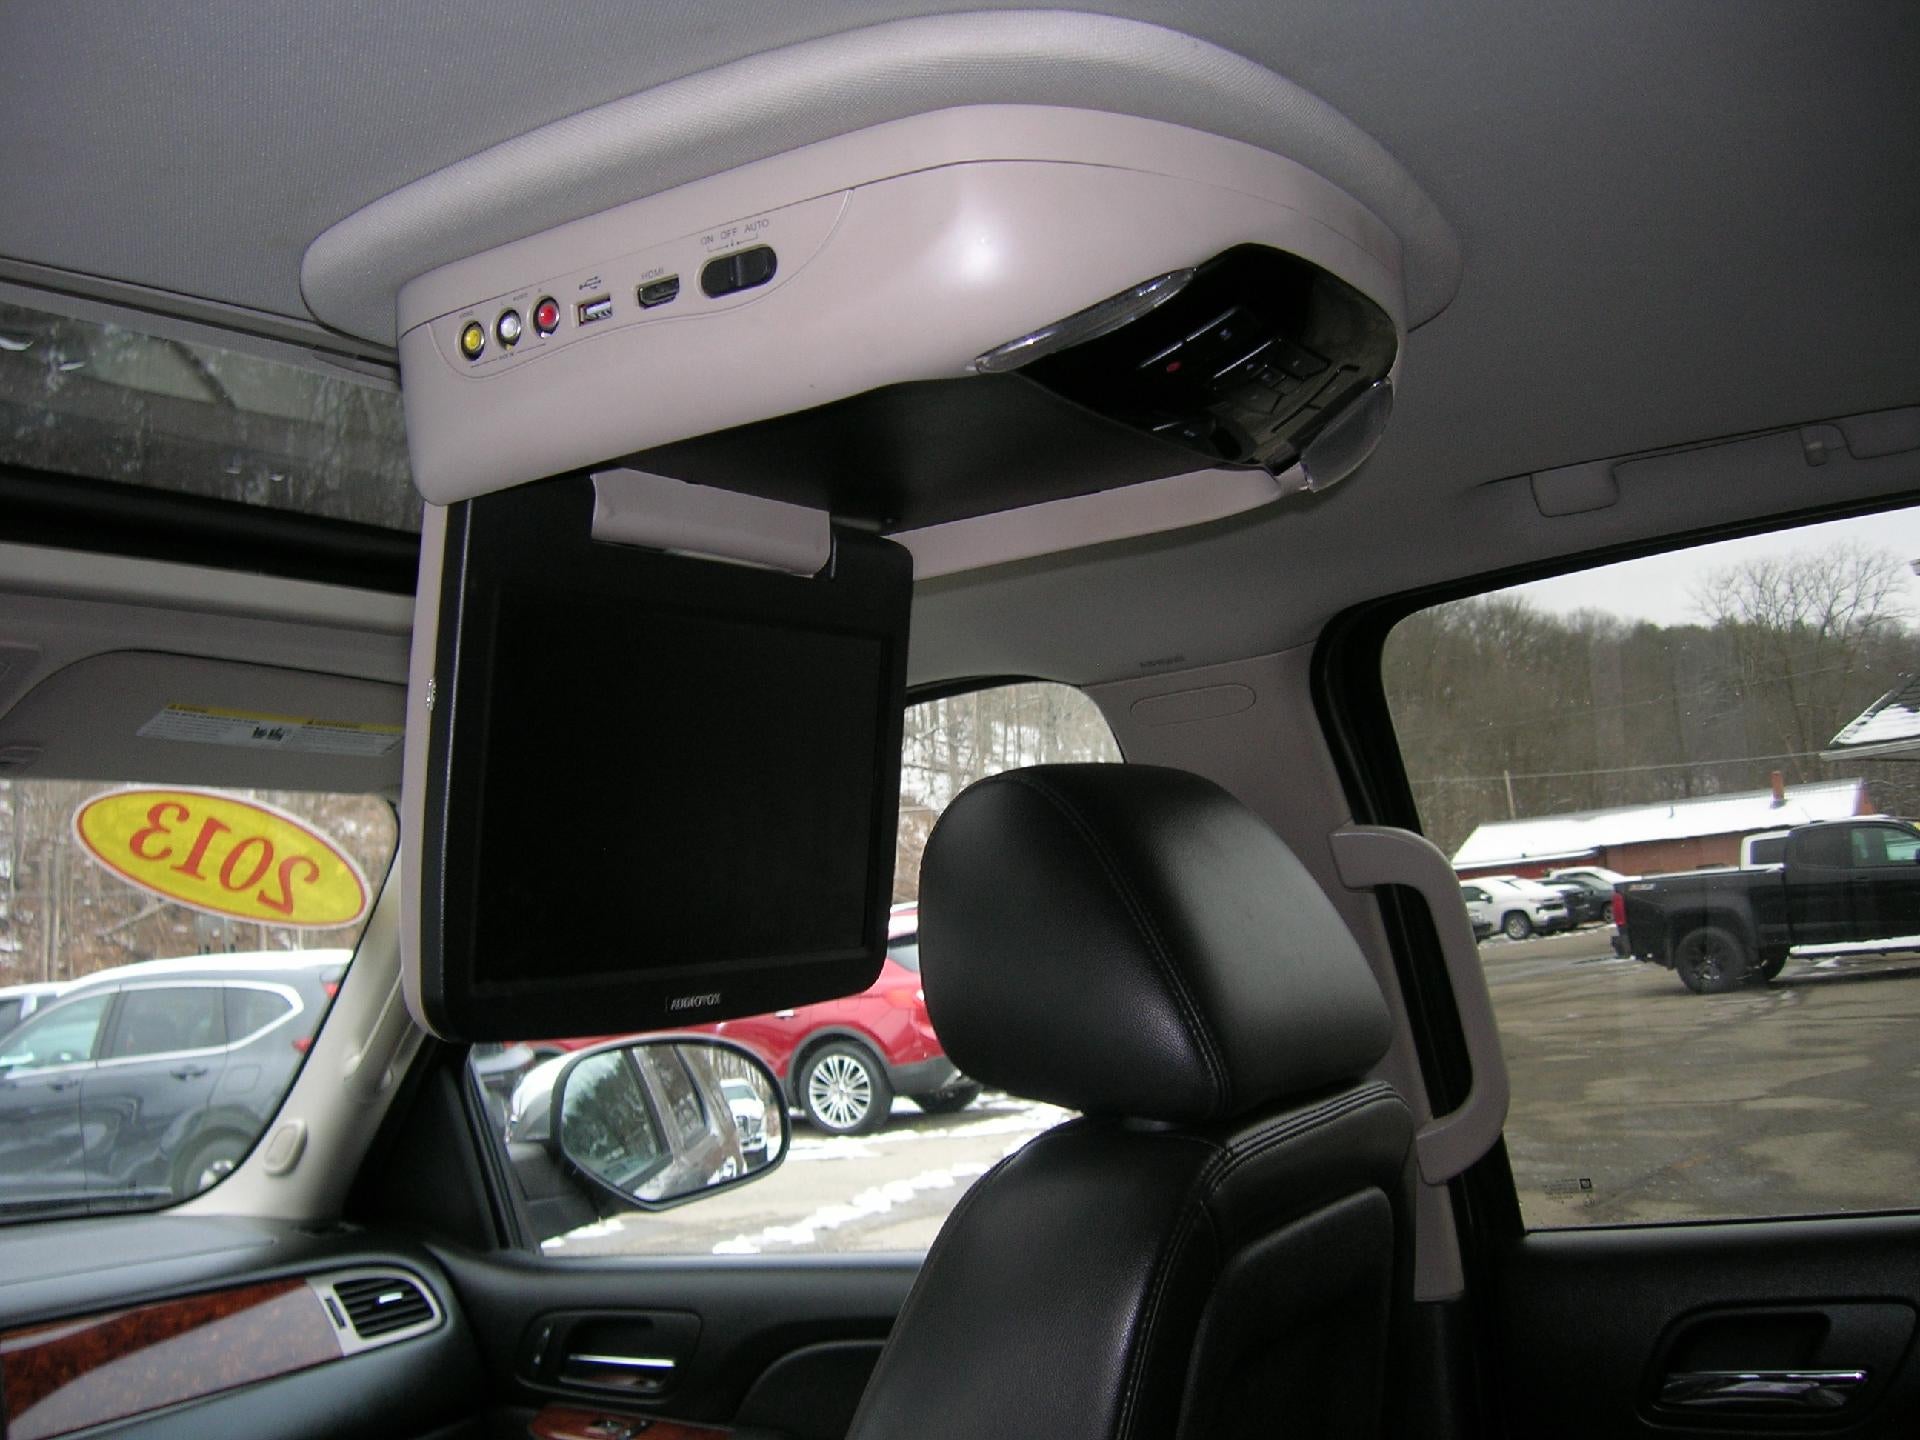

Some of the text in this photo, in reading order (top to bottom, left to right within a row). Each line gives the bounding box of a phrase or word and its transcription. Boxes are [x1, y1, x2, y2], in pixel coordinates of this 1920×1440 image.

[701, 219, 769, 245] ON OFF AUTO
[641, 267, 664, 280] HDMI
